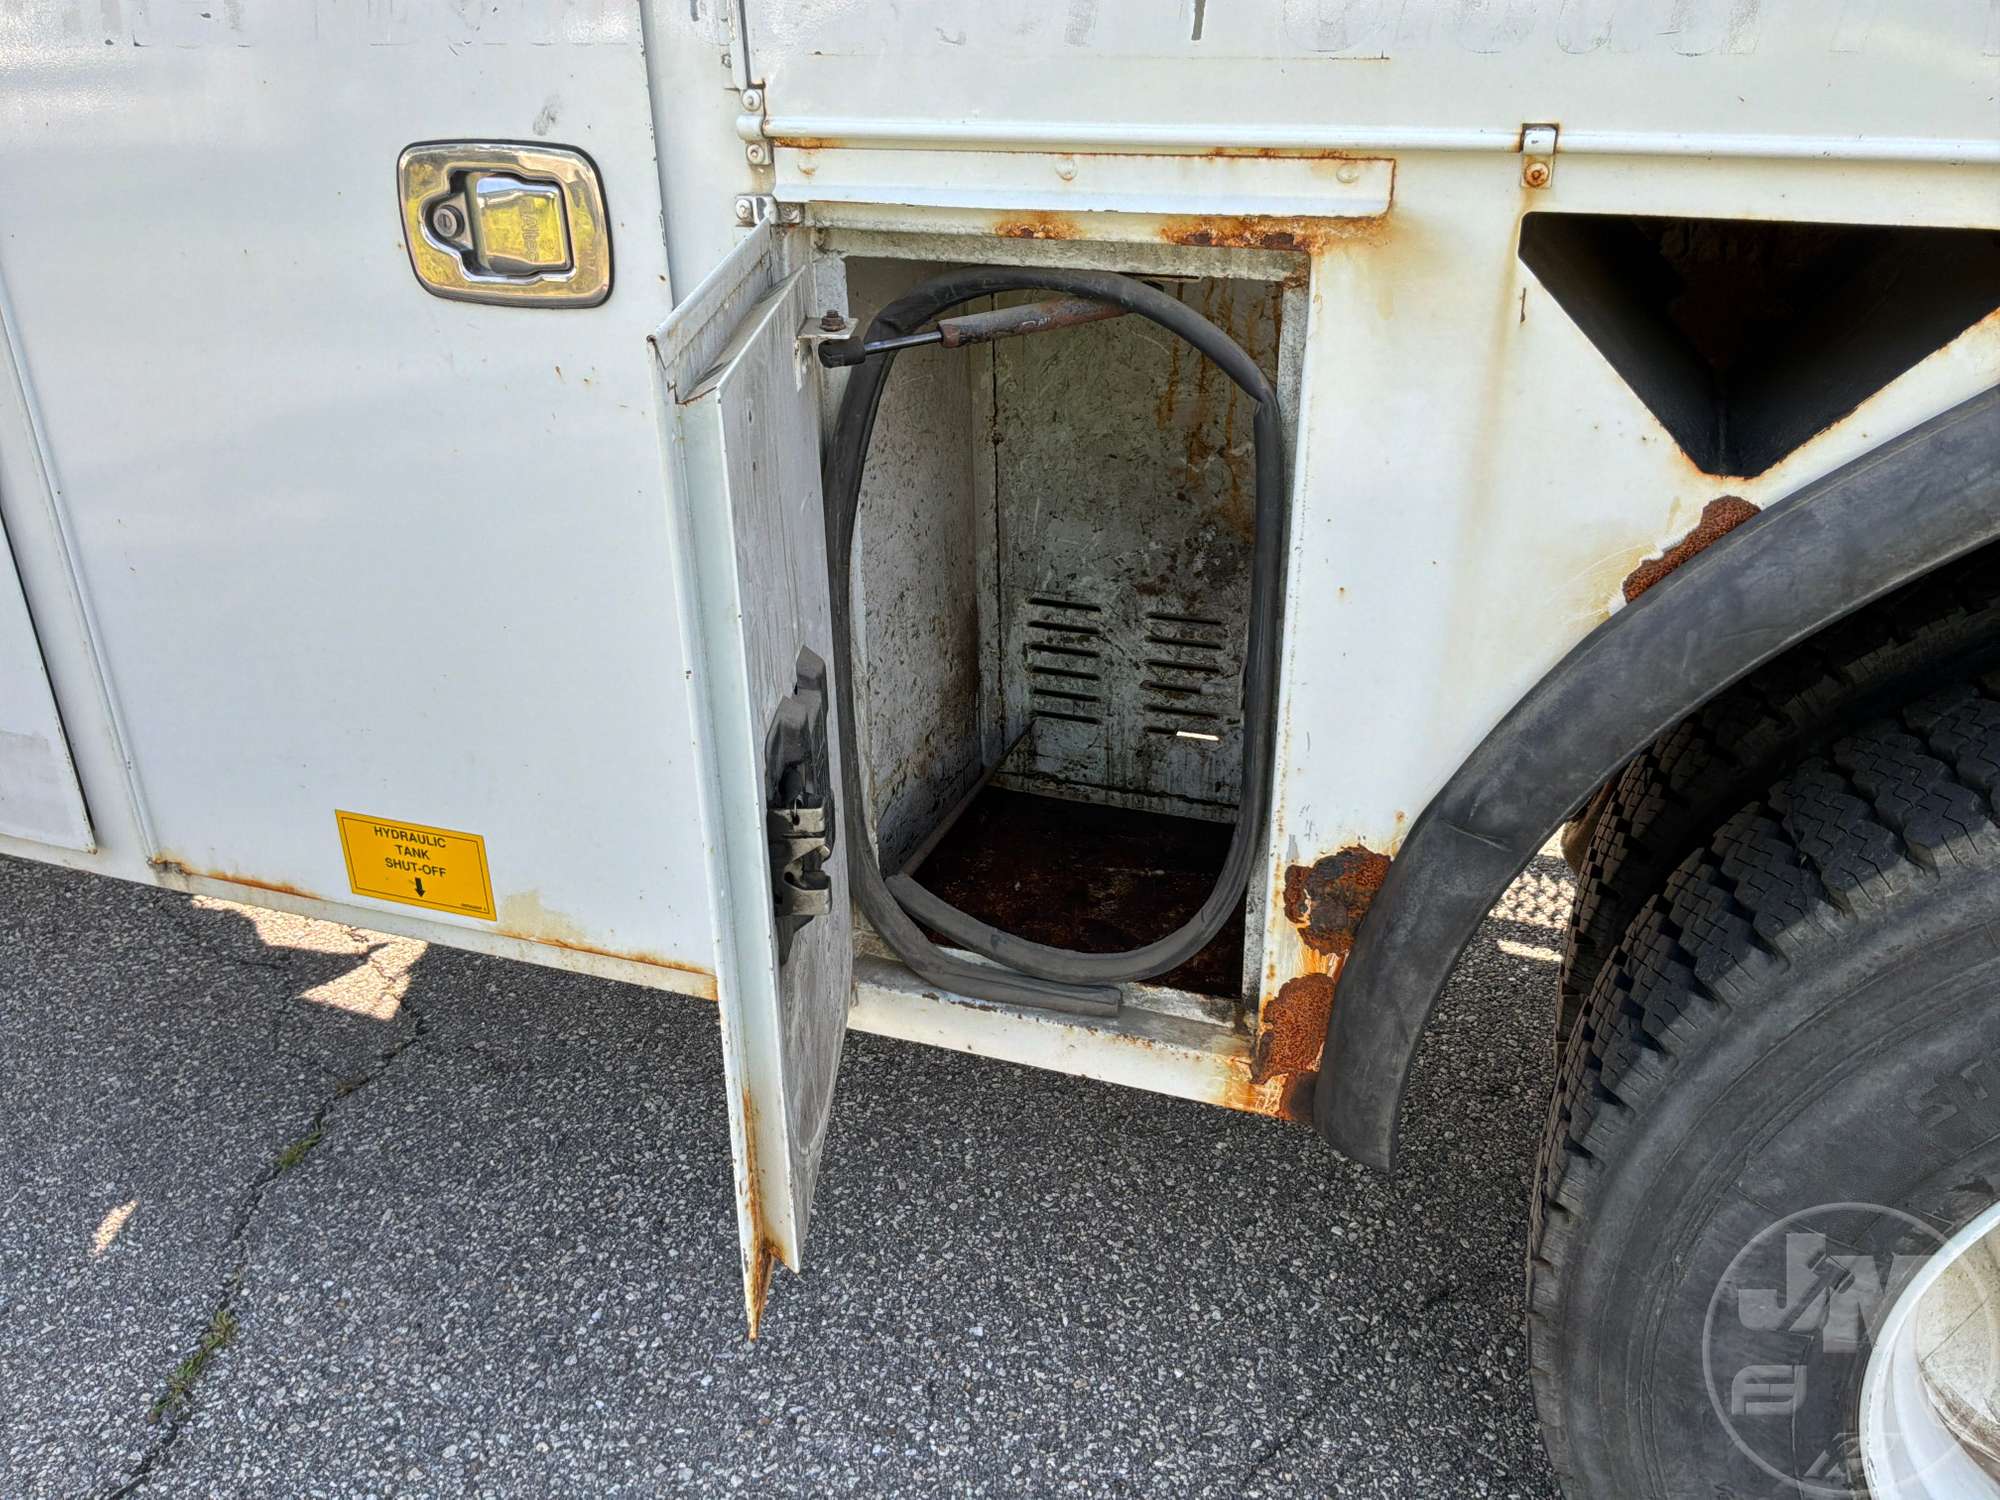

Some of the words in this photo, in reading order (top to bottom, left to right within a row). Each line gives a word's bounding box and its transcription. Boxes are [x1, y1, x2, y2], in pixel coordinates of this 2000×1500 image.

[374, 826, 447, 848] HYDRAULIC
[394, 844, 430, 860] TANK
[385, 857, 447, 877] SHUT-OFF
